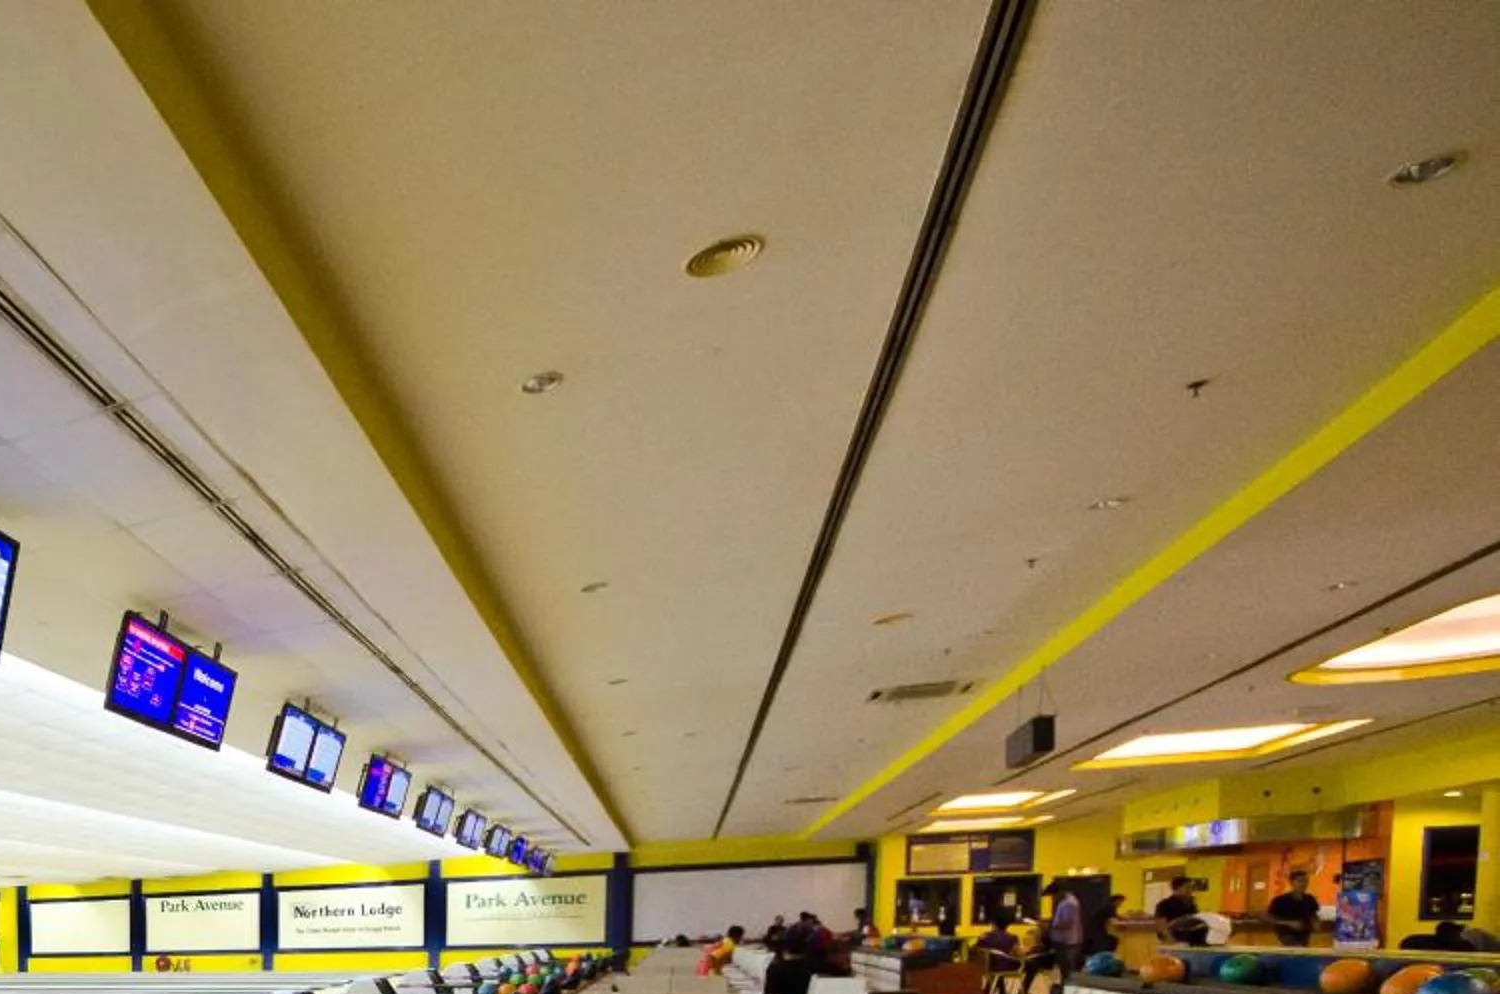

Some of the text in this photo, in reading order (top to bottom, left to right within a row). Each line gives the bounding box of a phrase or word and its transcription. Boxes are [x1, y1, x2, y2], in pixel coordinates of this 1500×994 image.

[160, 898, 245, 913] Park Avenue
[465, 891, 588, 909] Park Avenue
[293, 902, 403, 919] Northern Lodge
